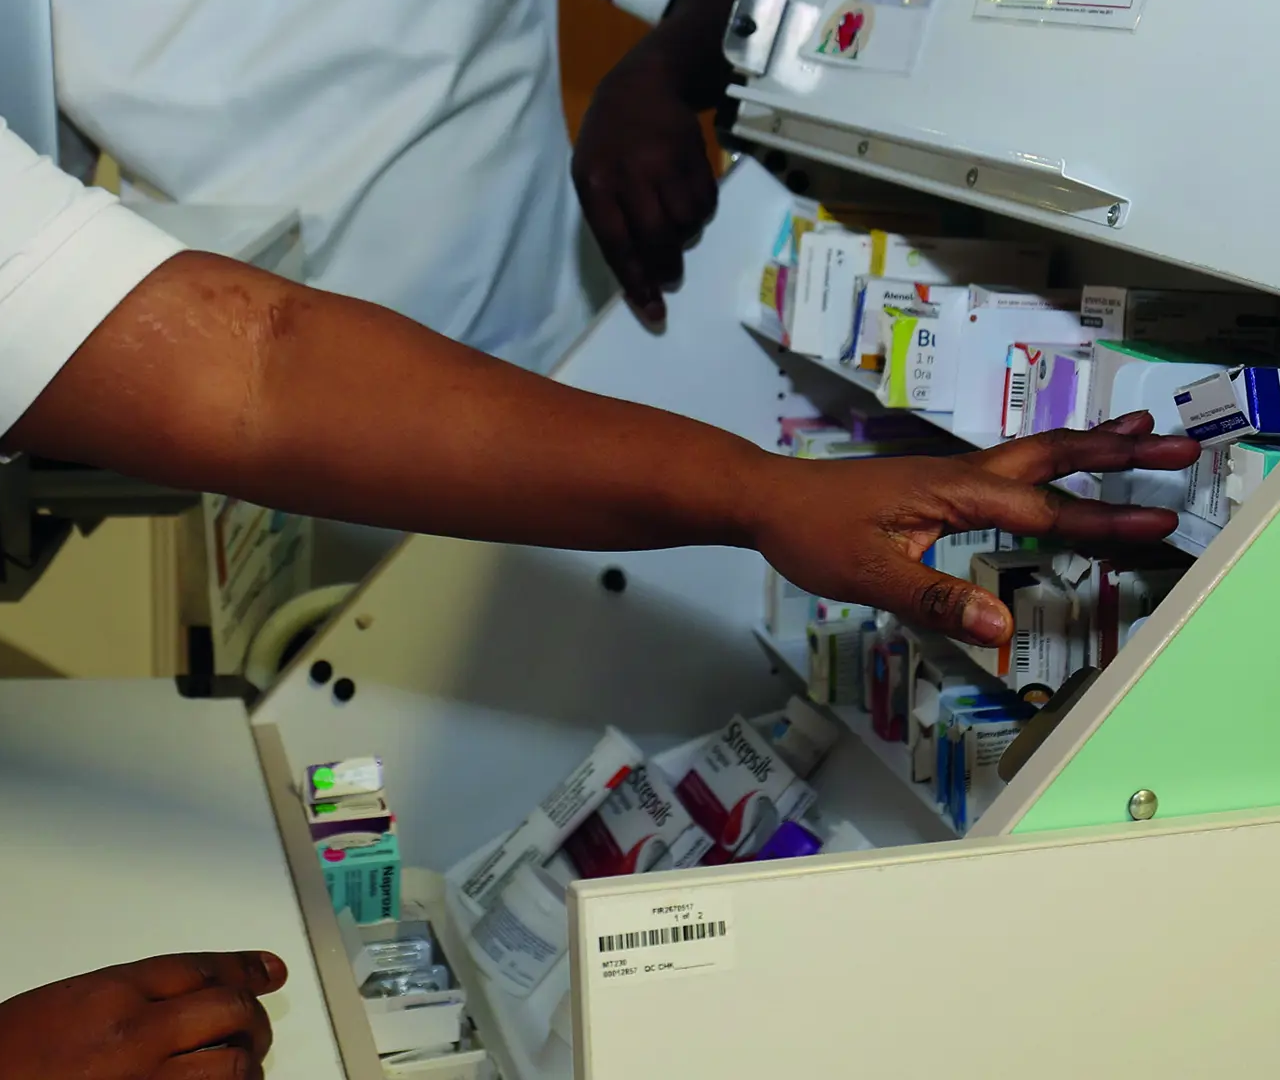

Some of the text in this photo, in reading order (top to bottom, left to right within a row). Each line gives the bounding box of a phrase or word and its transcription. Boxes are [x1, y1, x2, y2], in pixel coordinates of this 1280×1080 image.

[722, 721, 776, 784] Strepsils
[626, 763, 673, 828] Strepsils
[697, 911, 704, 919] 2
